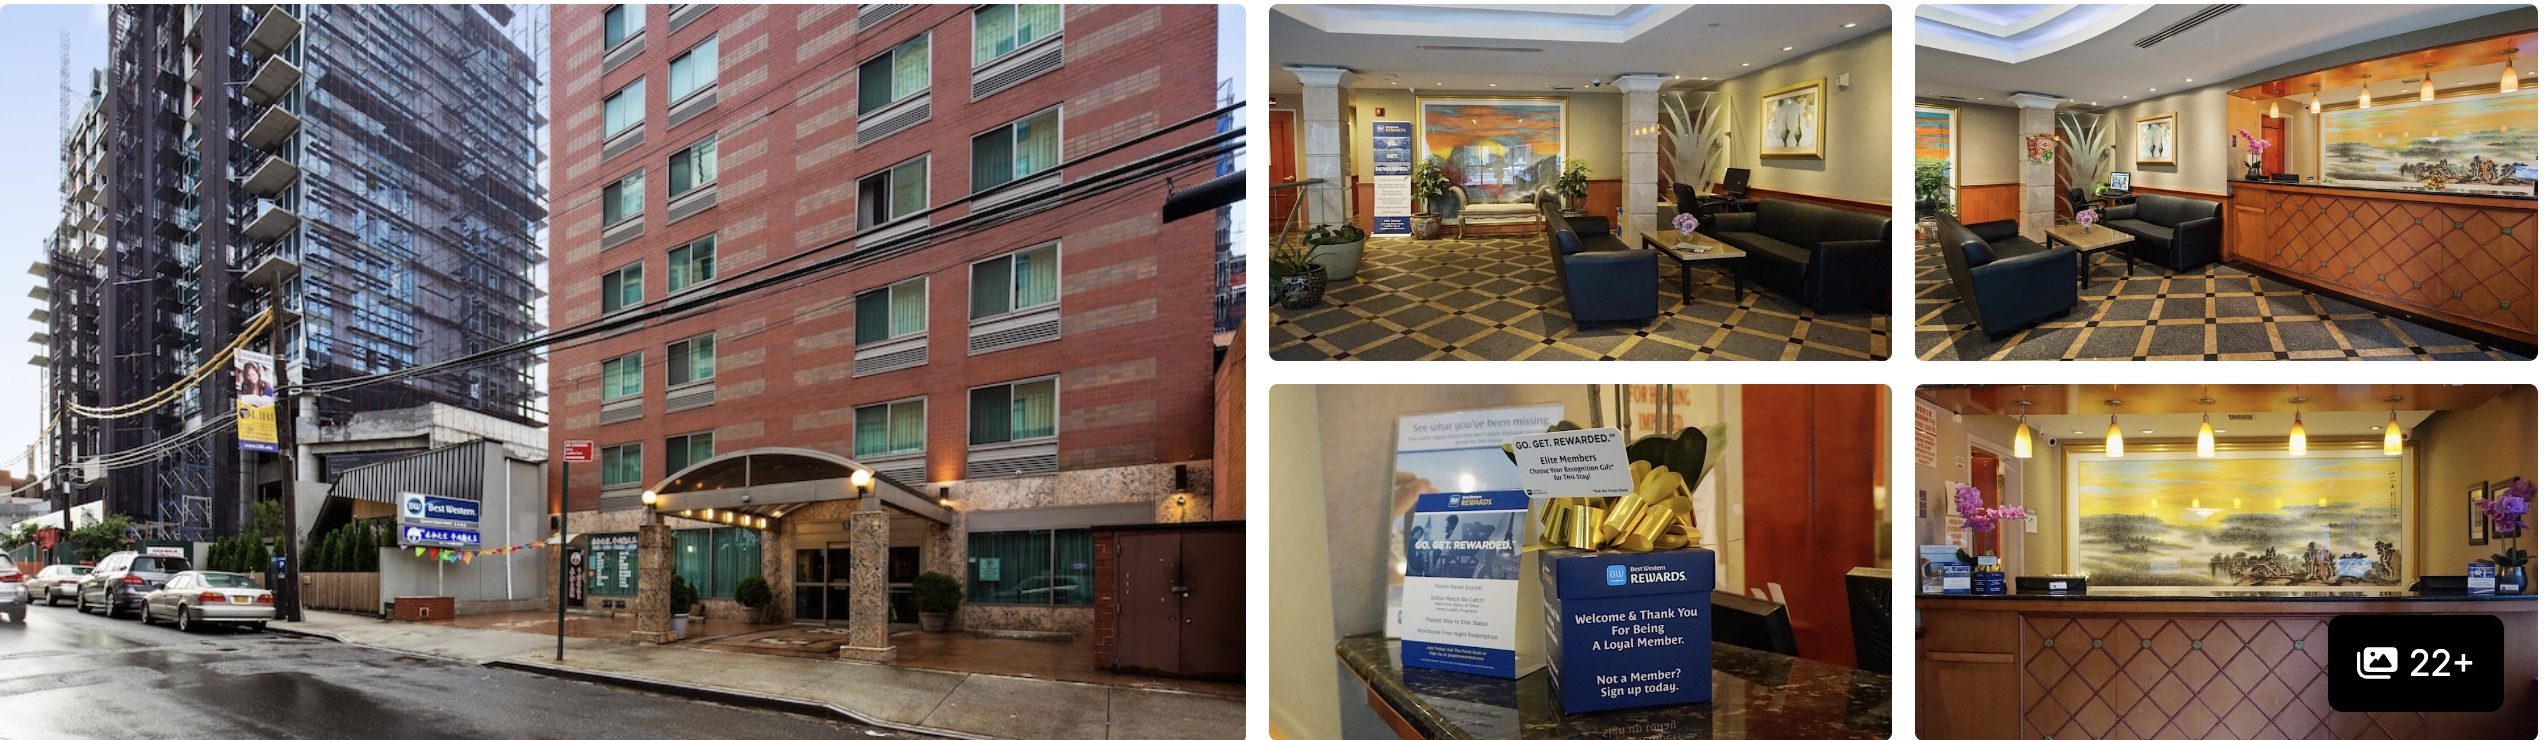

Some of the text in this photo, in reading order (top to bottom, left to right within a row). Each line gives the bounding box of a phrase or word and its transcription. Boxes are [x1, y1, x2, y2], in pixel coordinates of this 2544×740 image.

[1413, 416, 1550, 432] See what you've been missing.
[1516, 441, 1531, 450] GO.
[1532, 440, 1552, 448] GET.
[1540, 454, 1597, 465] Elite Members
[1564, 465, 1598, 474] Recognition
[1576, 473, 1592, 481] Stay!
[408, 502, 422, 510] BW
[428, 503, 445, 513] Best
[1414, 541, 1430, 550] GO.
[1432, 541, 1452, 550] GET.
[1610, 570, 1624, 578] BW
[1575, 608, 1698, 624] Welcome & Thank You
[1612, 623, 1664, 635] For Being
[1468, 632, 1498, 640] Redemption
[1592, 636, 1684, 651] A Loyal Member.
[1597, 675, 1618, 685] Not
[1631, 668, 1681, 682] Member?
[1601, 682, 1678, 698] Sign up today.
